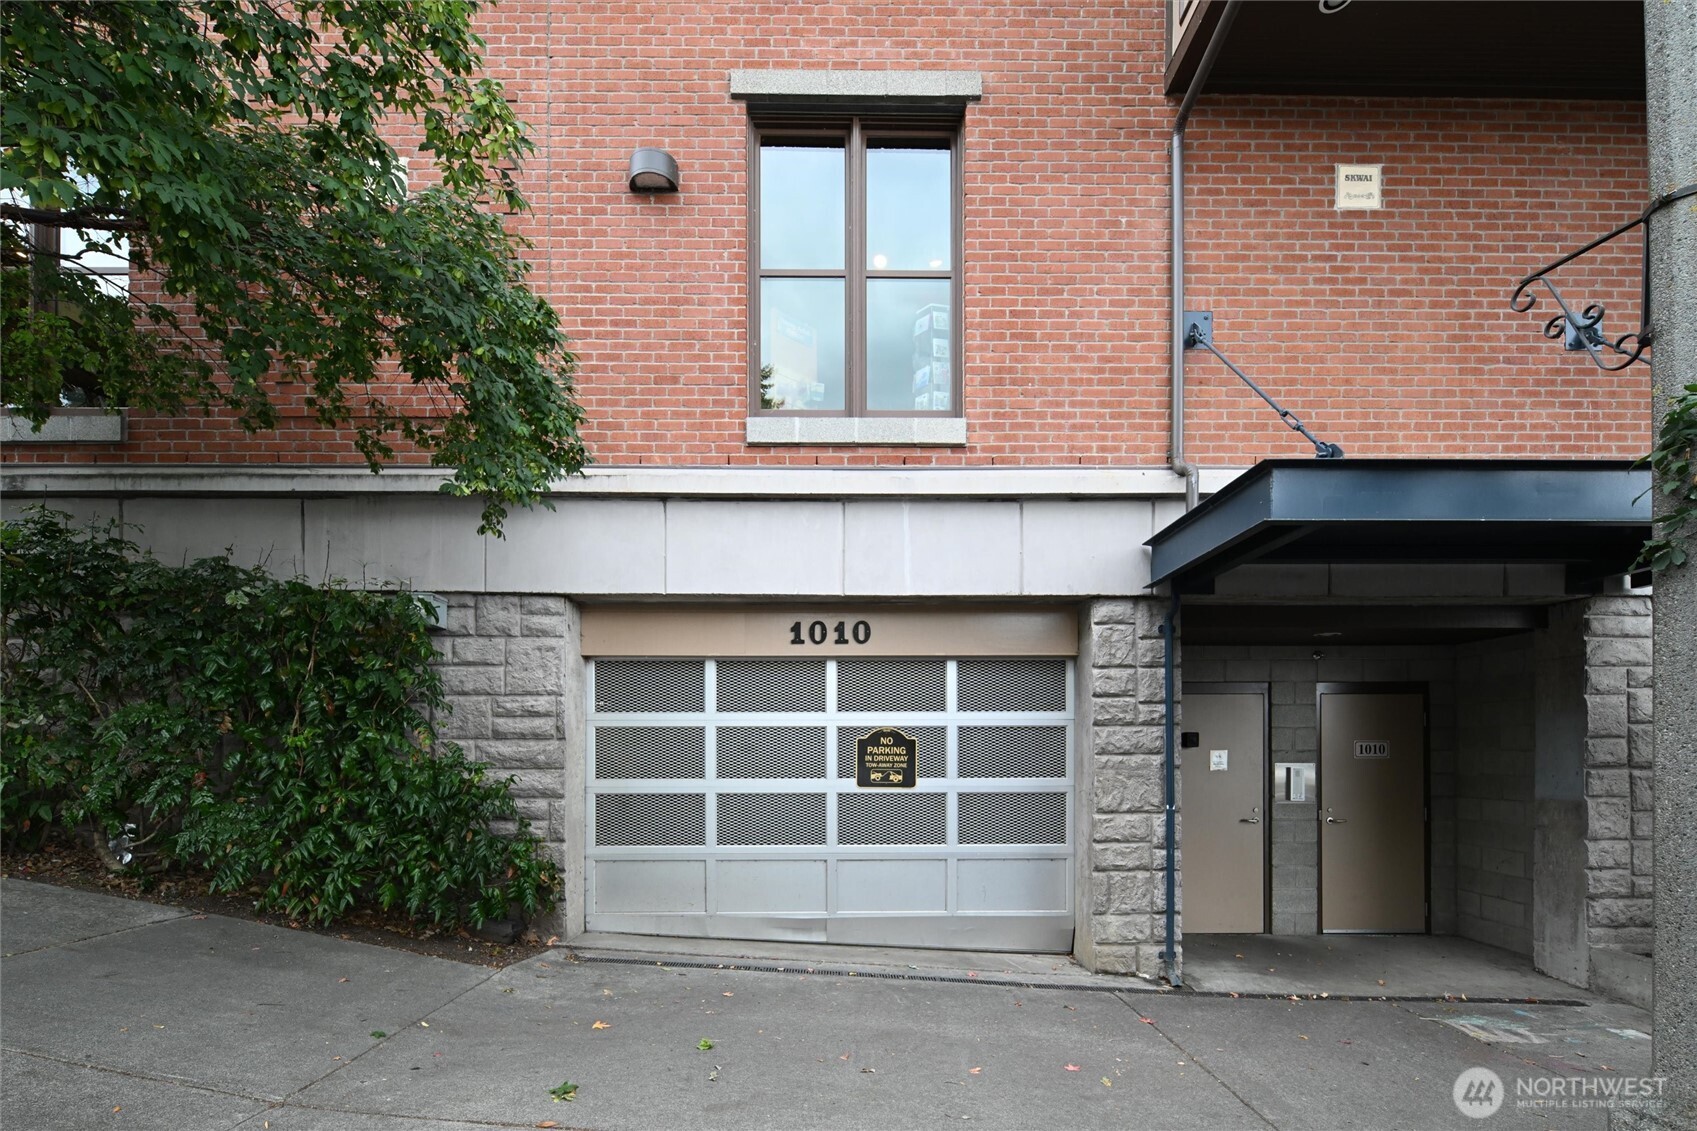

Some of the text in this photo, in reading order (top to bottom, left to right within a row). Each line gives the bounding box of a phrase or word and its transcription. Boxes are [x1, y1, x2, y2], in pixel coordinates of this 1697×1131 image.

[790, 620, 871, 645] 1010
[880, 737, 894, 745] NO
[867, 746, 906, 754] PARKING
[1359, 743, 1385, 755] 1010
